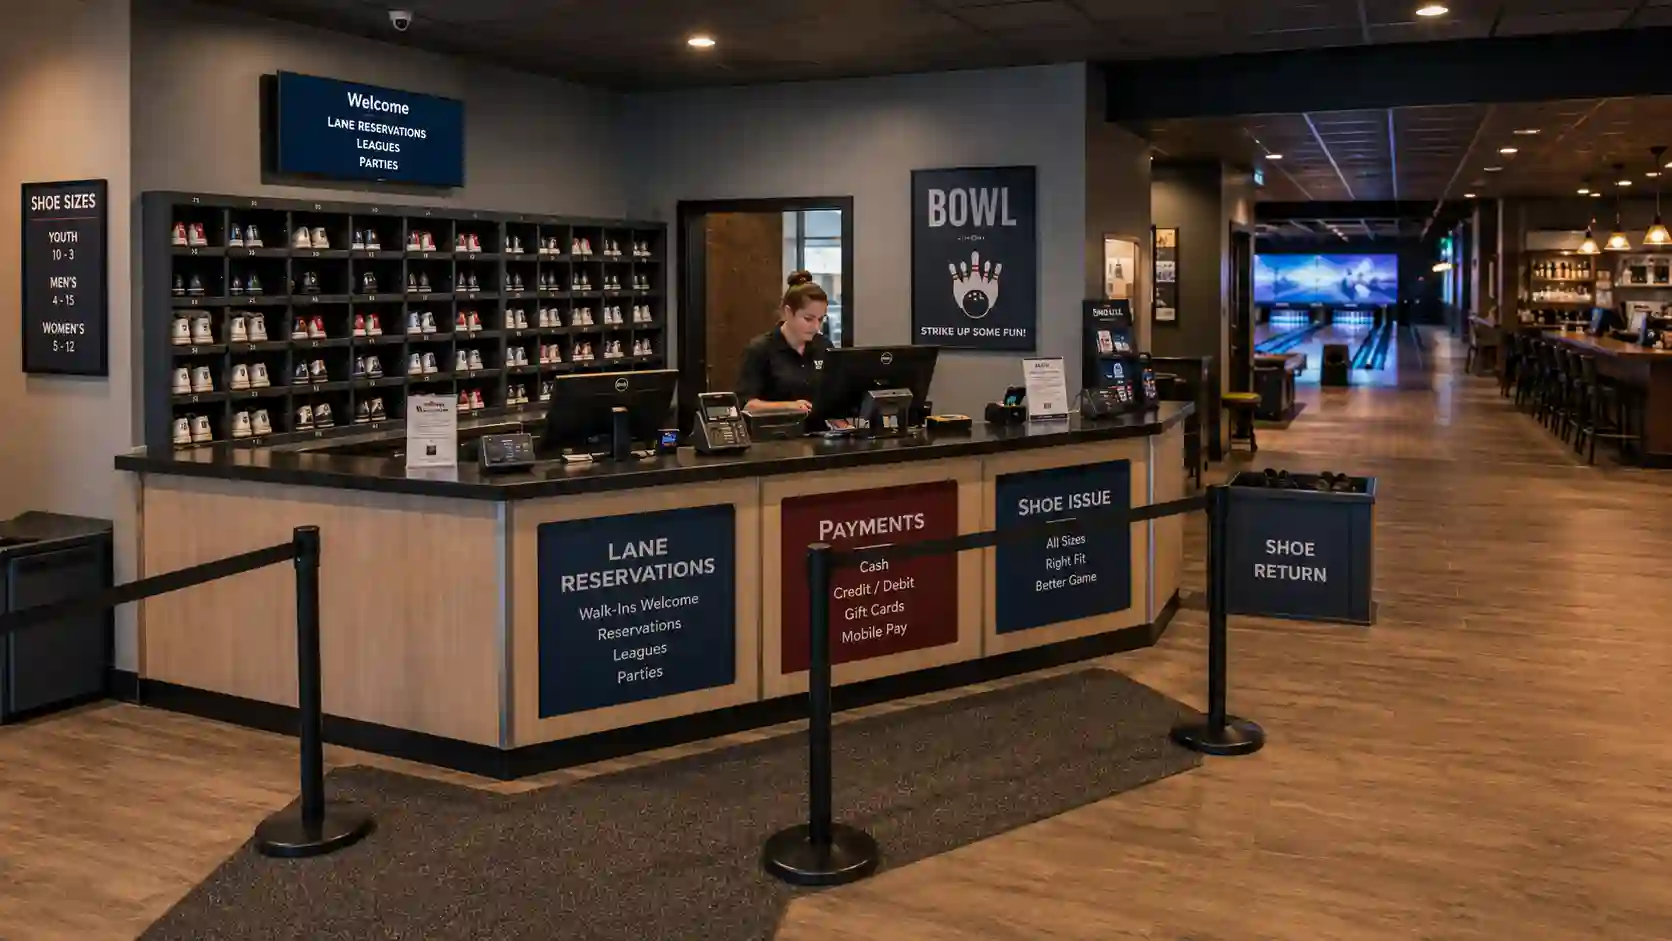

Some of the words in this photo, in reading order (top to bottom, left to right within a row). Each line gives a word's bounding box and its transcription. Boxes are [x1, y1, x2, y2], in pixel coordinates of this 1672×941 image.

[348, 92, 409, 114] Welcome
[328, 116, 355, 130] LANE
[357, 121, 427, 139] RESERVATIONS
[357, 139, 400, 152] LEAGUES
[360, 157, 398, 170] PARTIES
[32, 196, 60, 210] SHOE
[64, 193, 95, 209] SIZES
[929, 188, 1016, 227] BOWL
[49, 232, 77, 243] YOUTH
[53, 249, 61, 260] 10
[69, 249, 74, 260] 3
[50, 277, 76, 288] MEN'S
[53, 296, 57, 304] 4
[66, 295, 74, 305] 15
[43, 322, 84, 334] WOMEN'S
[921, 327, 954, 335] STRIKE
[973, 328, 1000, 336] SOME
[1003, 329, 1026, 337] FUN!
[53, 340, 58, 351] 5
[66, 341, 74, 352] 12
[1019, 496, 1062, 515] SHOE
[1069, 491, 1110, 509] ISSUE
[820, 513, 924, 540] PAYMENTS
[609, 538, 667, 560] LANE
[1047, 537, 1059, 548] All
[1062, 535, 1085, 546] Sizes
[1266, 540, 1314, 556] SHOE
[860, 559, 888, 573] Cash
[1046, 556, 1071, 570] Right
[1074, 553, 1087, 564] Fit
[562, 557, 716, 592] RESERVATIONS
[1255, 564, 1326, 582] RETURN
[834, 584, 870, 599] Credit
[874, 581, 879, 595] /
[884, 577, 914, 592] Debit
[1035, 579, 1066, 591] Better
[1069, 573, 1097, 585] Game
[580, 603, 636, 620] Walk-Ins
[641, 596, 698, 611] Welcome
[845, 606, 867, 620] Gift
[871, 601, 904, 616] Cards
[597, 618, 682, 640] Reservations
[843, 626, 882, 643] Mobile
[887, 624, 907, 636] Pay
[613, 644, 668, 661] Leagues
[618, 667, 662, 683] Parties
